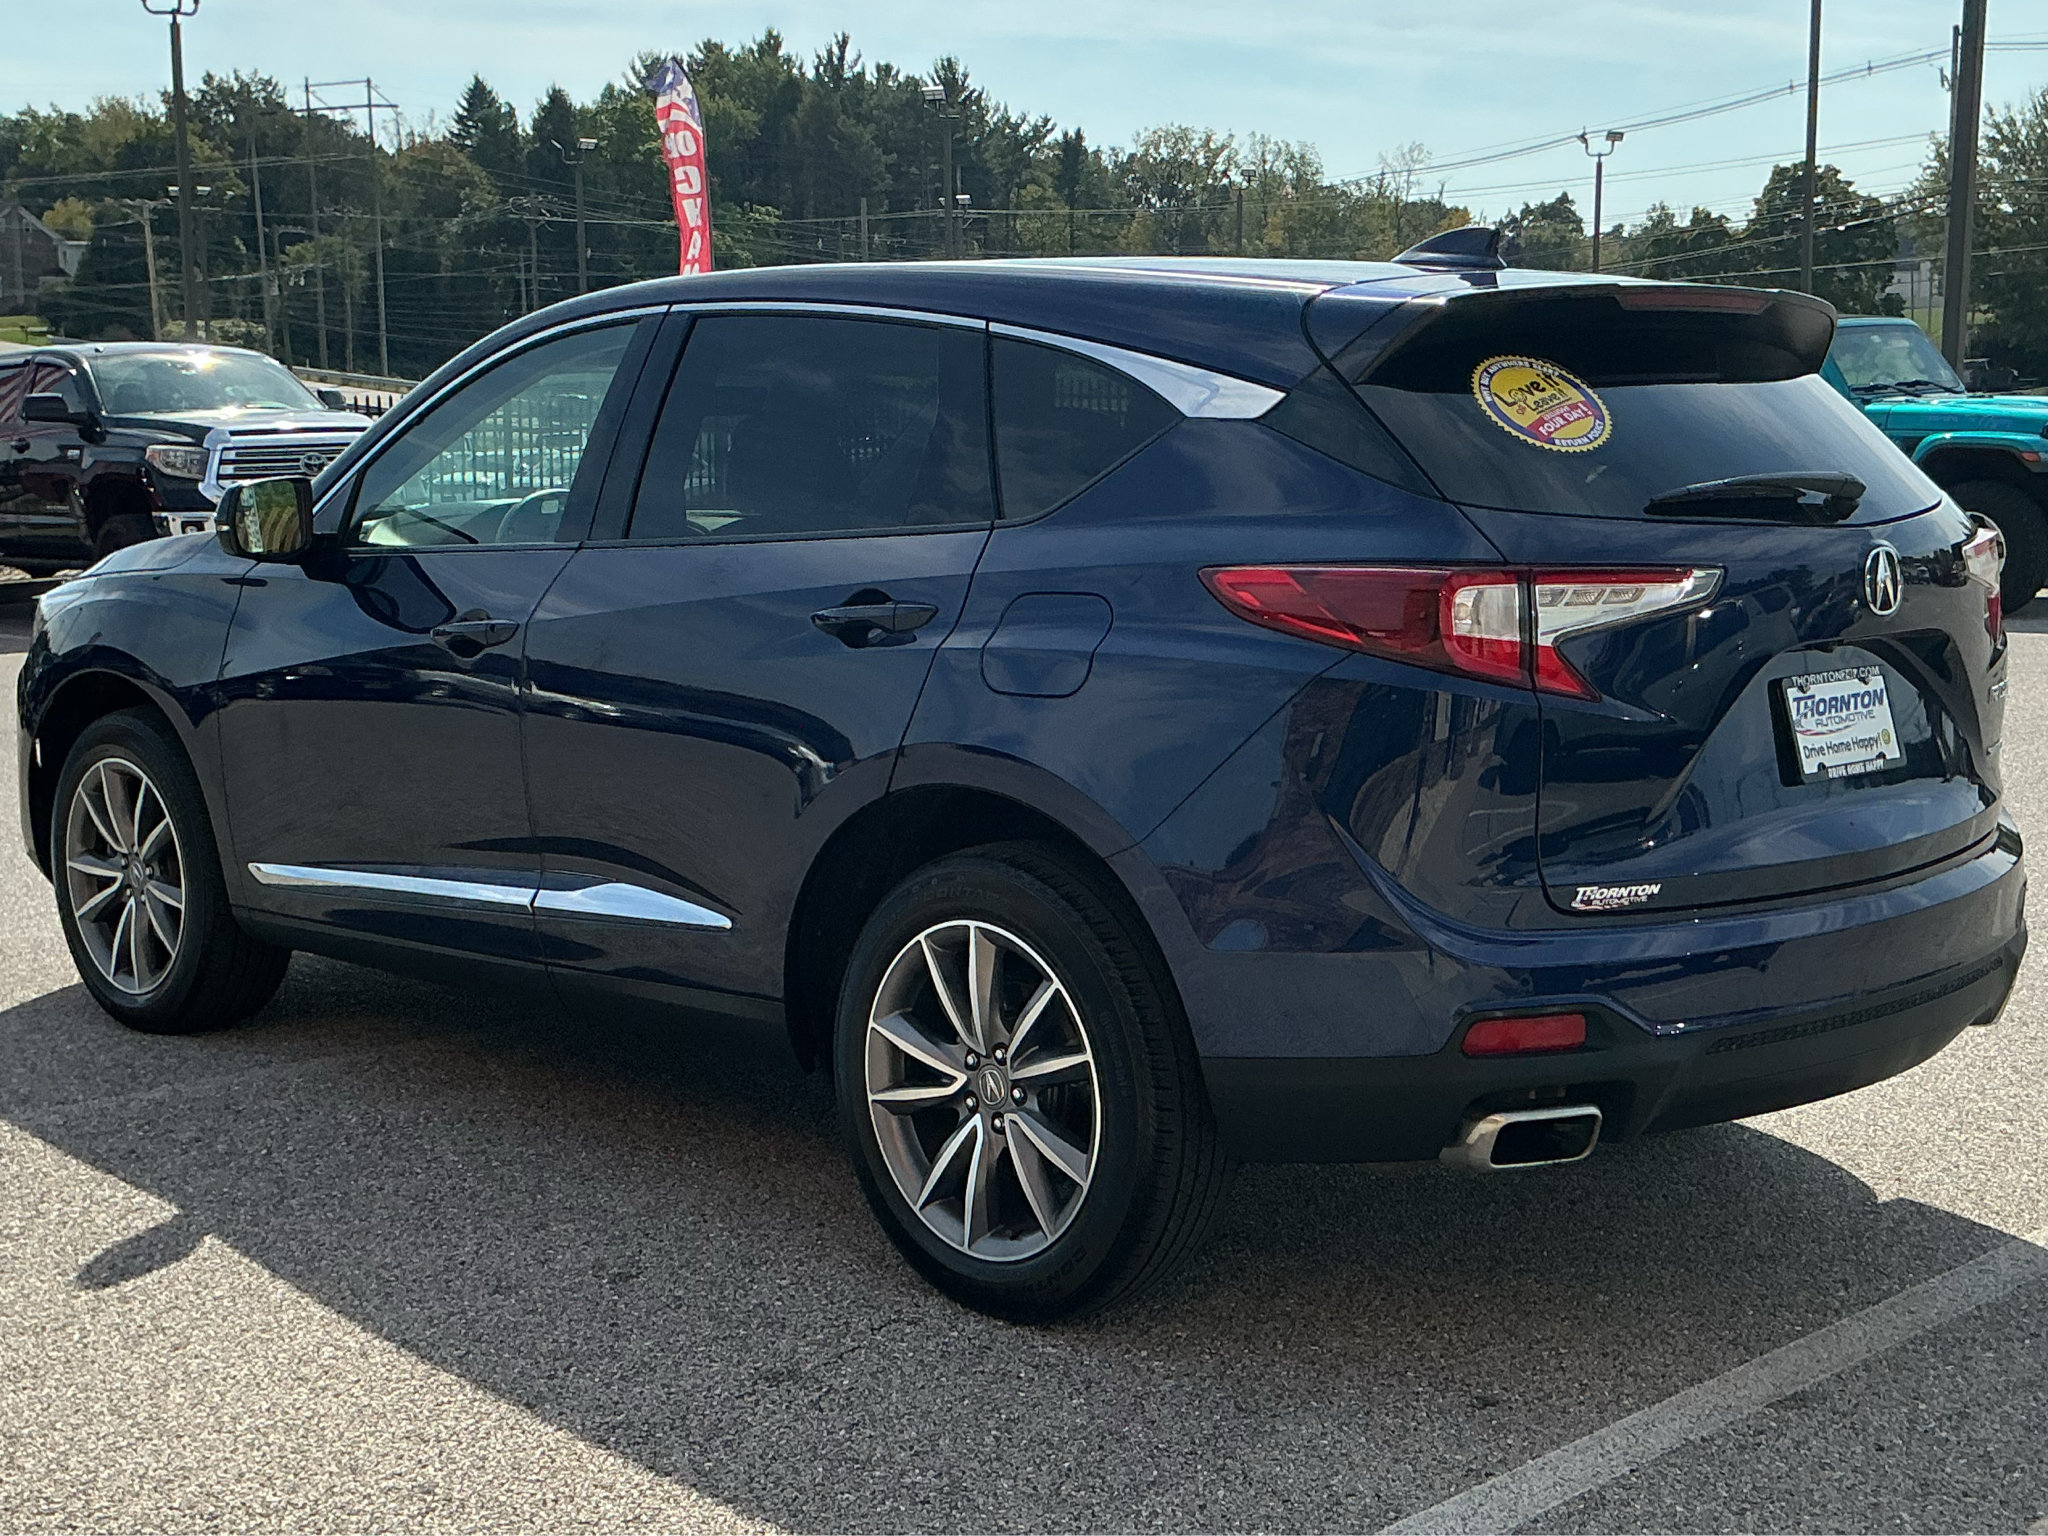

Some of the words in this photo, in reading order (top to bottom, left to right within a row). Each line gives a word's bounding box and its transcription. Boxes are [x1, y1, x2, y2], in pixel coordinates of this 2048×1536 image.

[1492, 381, 1547, 407] Love
[1538, 416, 1568, 436] FOUR
[1554, 436, 1591, 446] RETURN
[1792, 688, 1885, 719] THORNTON
[1815, 709, 1876, 728] AUTOMOTIVE
[1803, 743, 1825, 759] Drive
[1826, 739, 1851, 754] Home
[1576, 884, 1662, 902] THORNTON
[1592, 895, 1648, 906] AUTOMOTIVE
